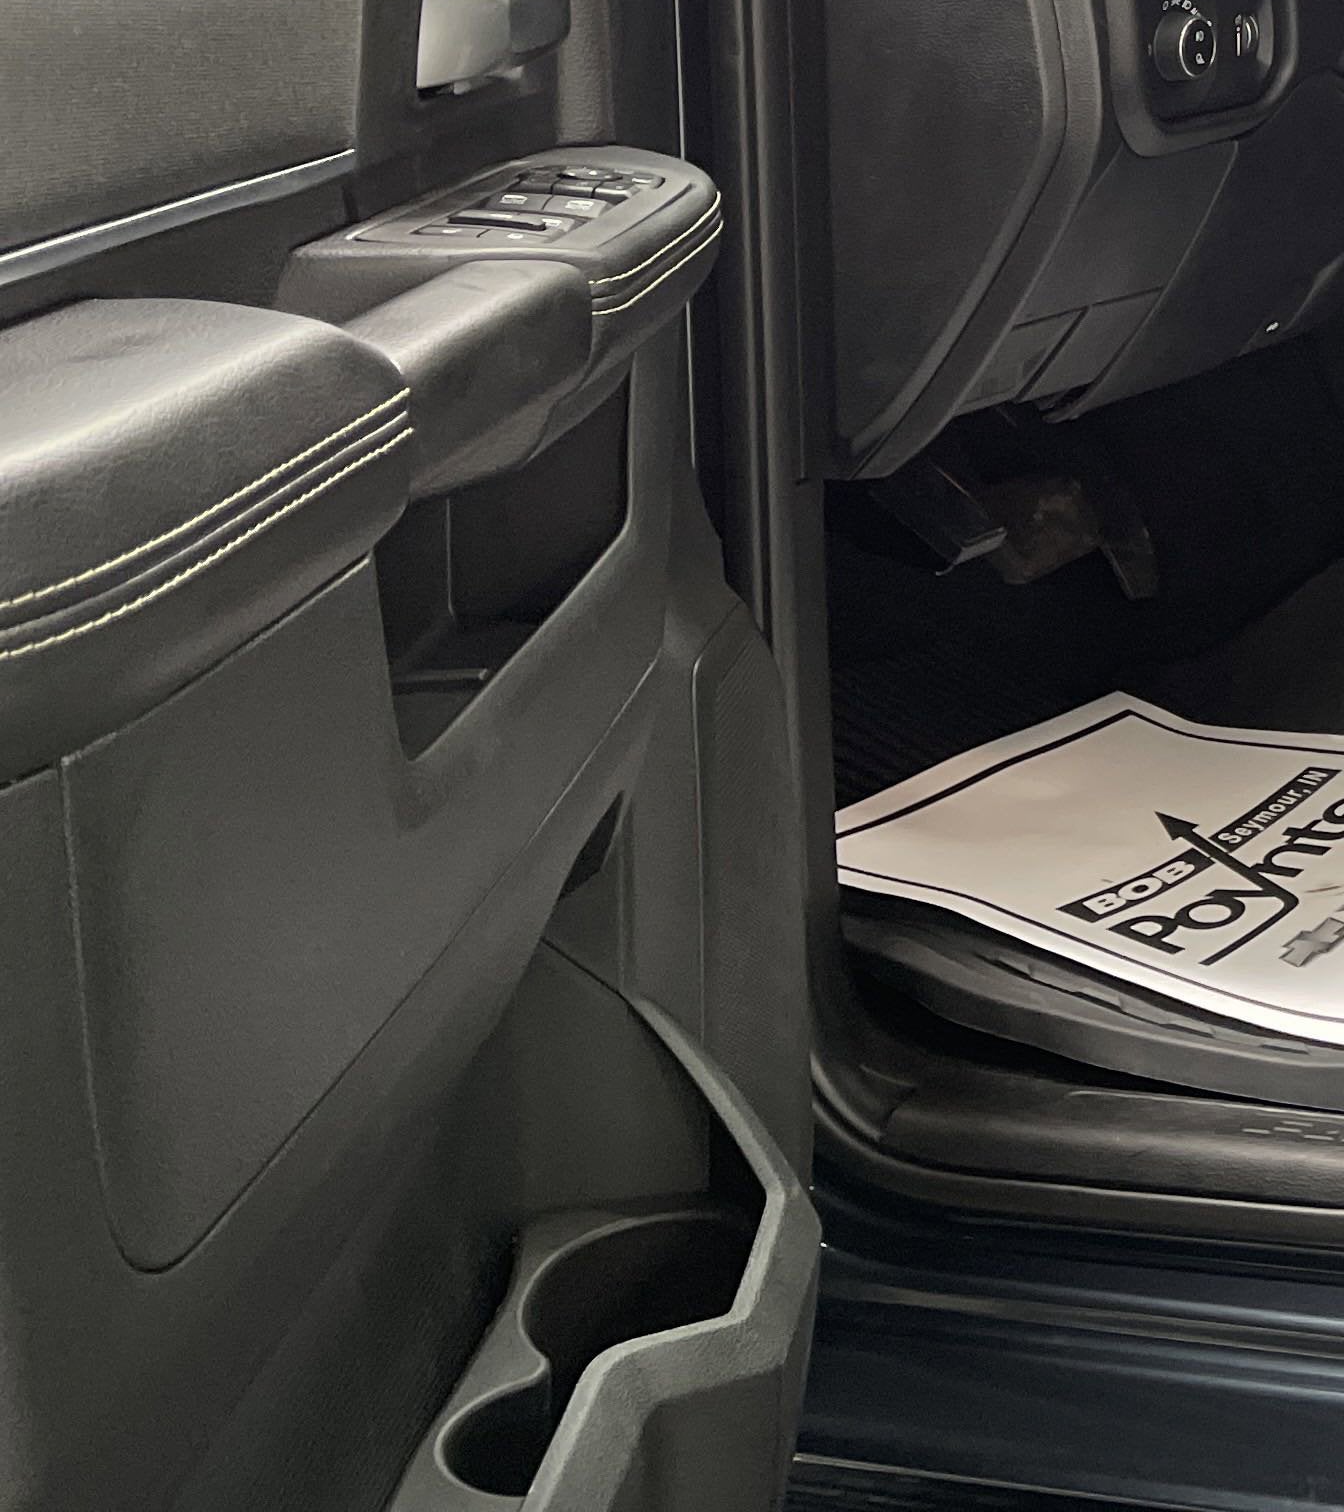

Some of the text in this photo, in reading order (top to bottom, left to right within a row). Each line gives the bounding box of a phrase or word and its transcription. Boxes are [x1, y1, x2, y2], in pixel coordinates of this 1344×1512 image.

[1217, 770, 1329, 844] Seymour, IN
[1082, 860, 1196, 915] BOB
